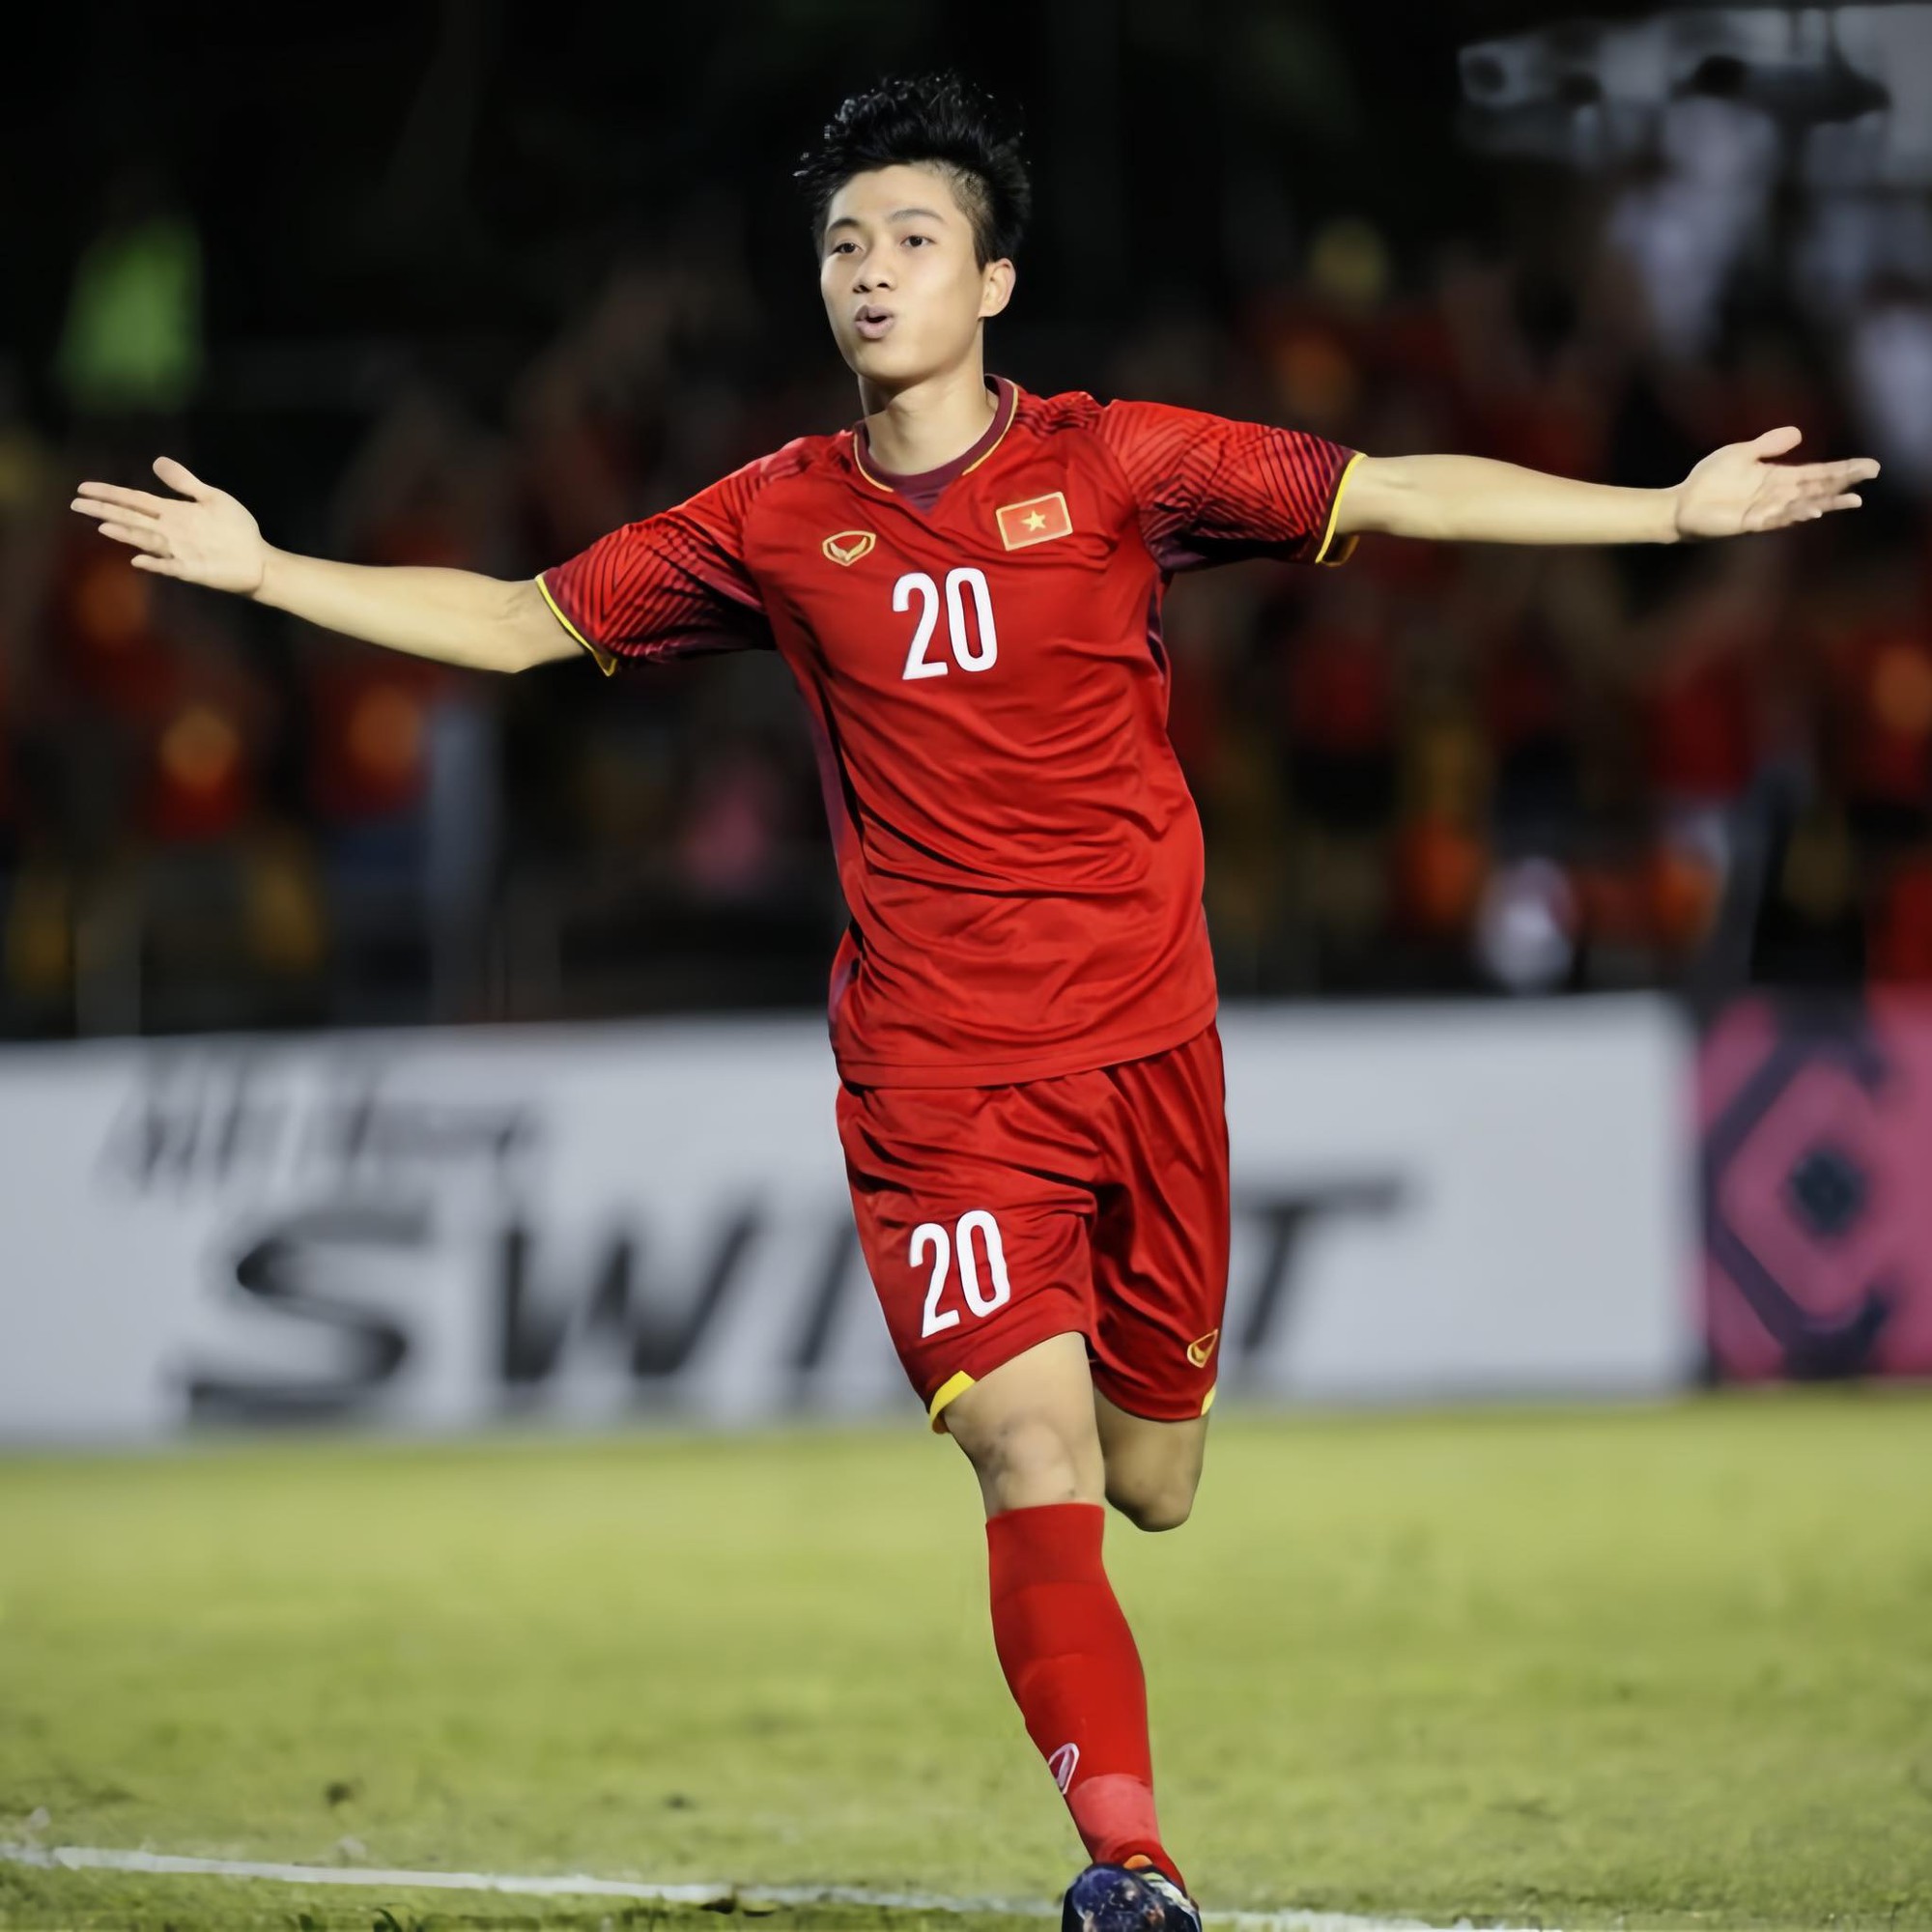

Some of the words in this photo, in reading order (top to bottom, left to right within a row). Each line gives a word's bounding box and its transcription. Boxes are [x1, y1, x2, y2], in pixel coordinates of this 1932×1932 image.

[892, 567, 998, 681] 20
[179, 1171, 1408, 1422] SWIT
[908, 1209, 1011, 1339] 20
